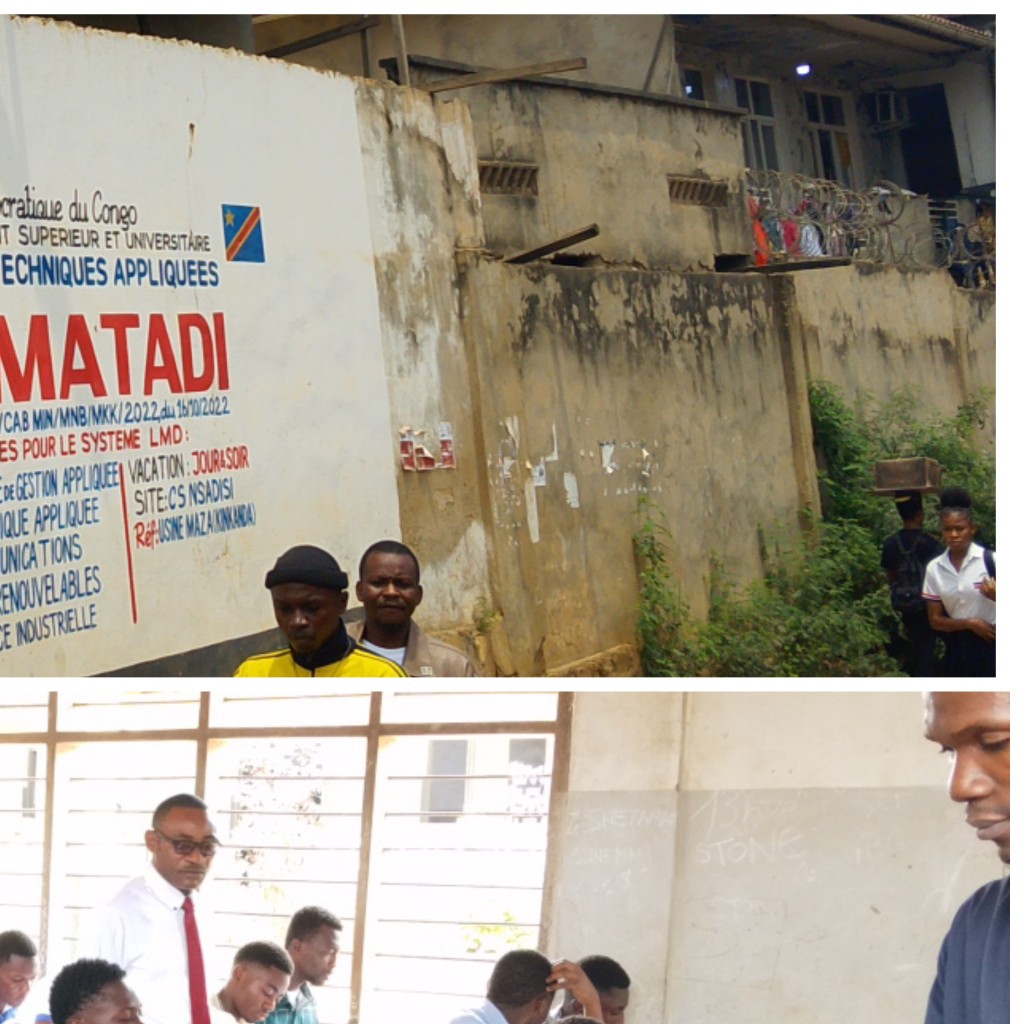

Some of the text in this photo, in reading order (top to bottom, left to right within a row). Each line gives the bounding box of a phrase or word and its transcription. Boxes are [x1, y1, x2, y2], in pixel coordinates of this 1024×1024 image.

[69, 189, 89, 223] du
[91, 190, 138, 231] Congo
[18, 227, 100, 249] SUPERIEUR
[105, 231, 120, 249] ET
[125, 231, 211, 252] UNIVERSITAIRE
[113, 257, 219, 288] APPLIQUEES
[23, 438, 57, 460] POUR
[60, 434, 76, 456] LE
[81, 428, 141, 453] SYSTEME
[16, 469, 57, 501] GESTION
[62, 461, 119, 494] APPLIQUEE
[34, 497, 100, 535] APPLIQUEE
[16, 603, 97, 646] INDUSTRIELLE
